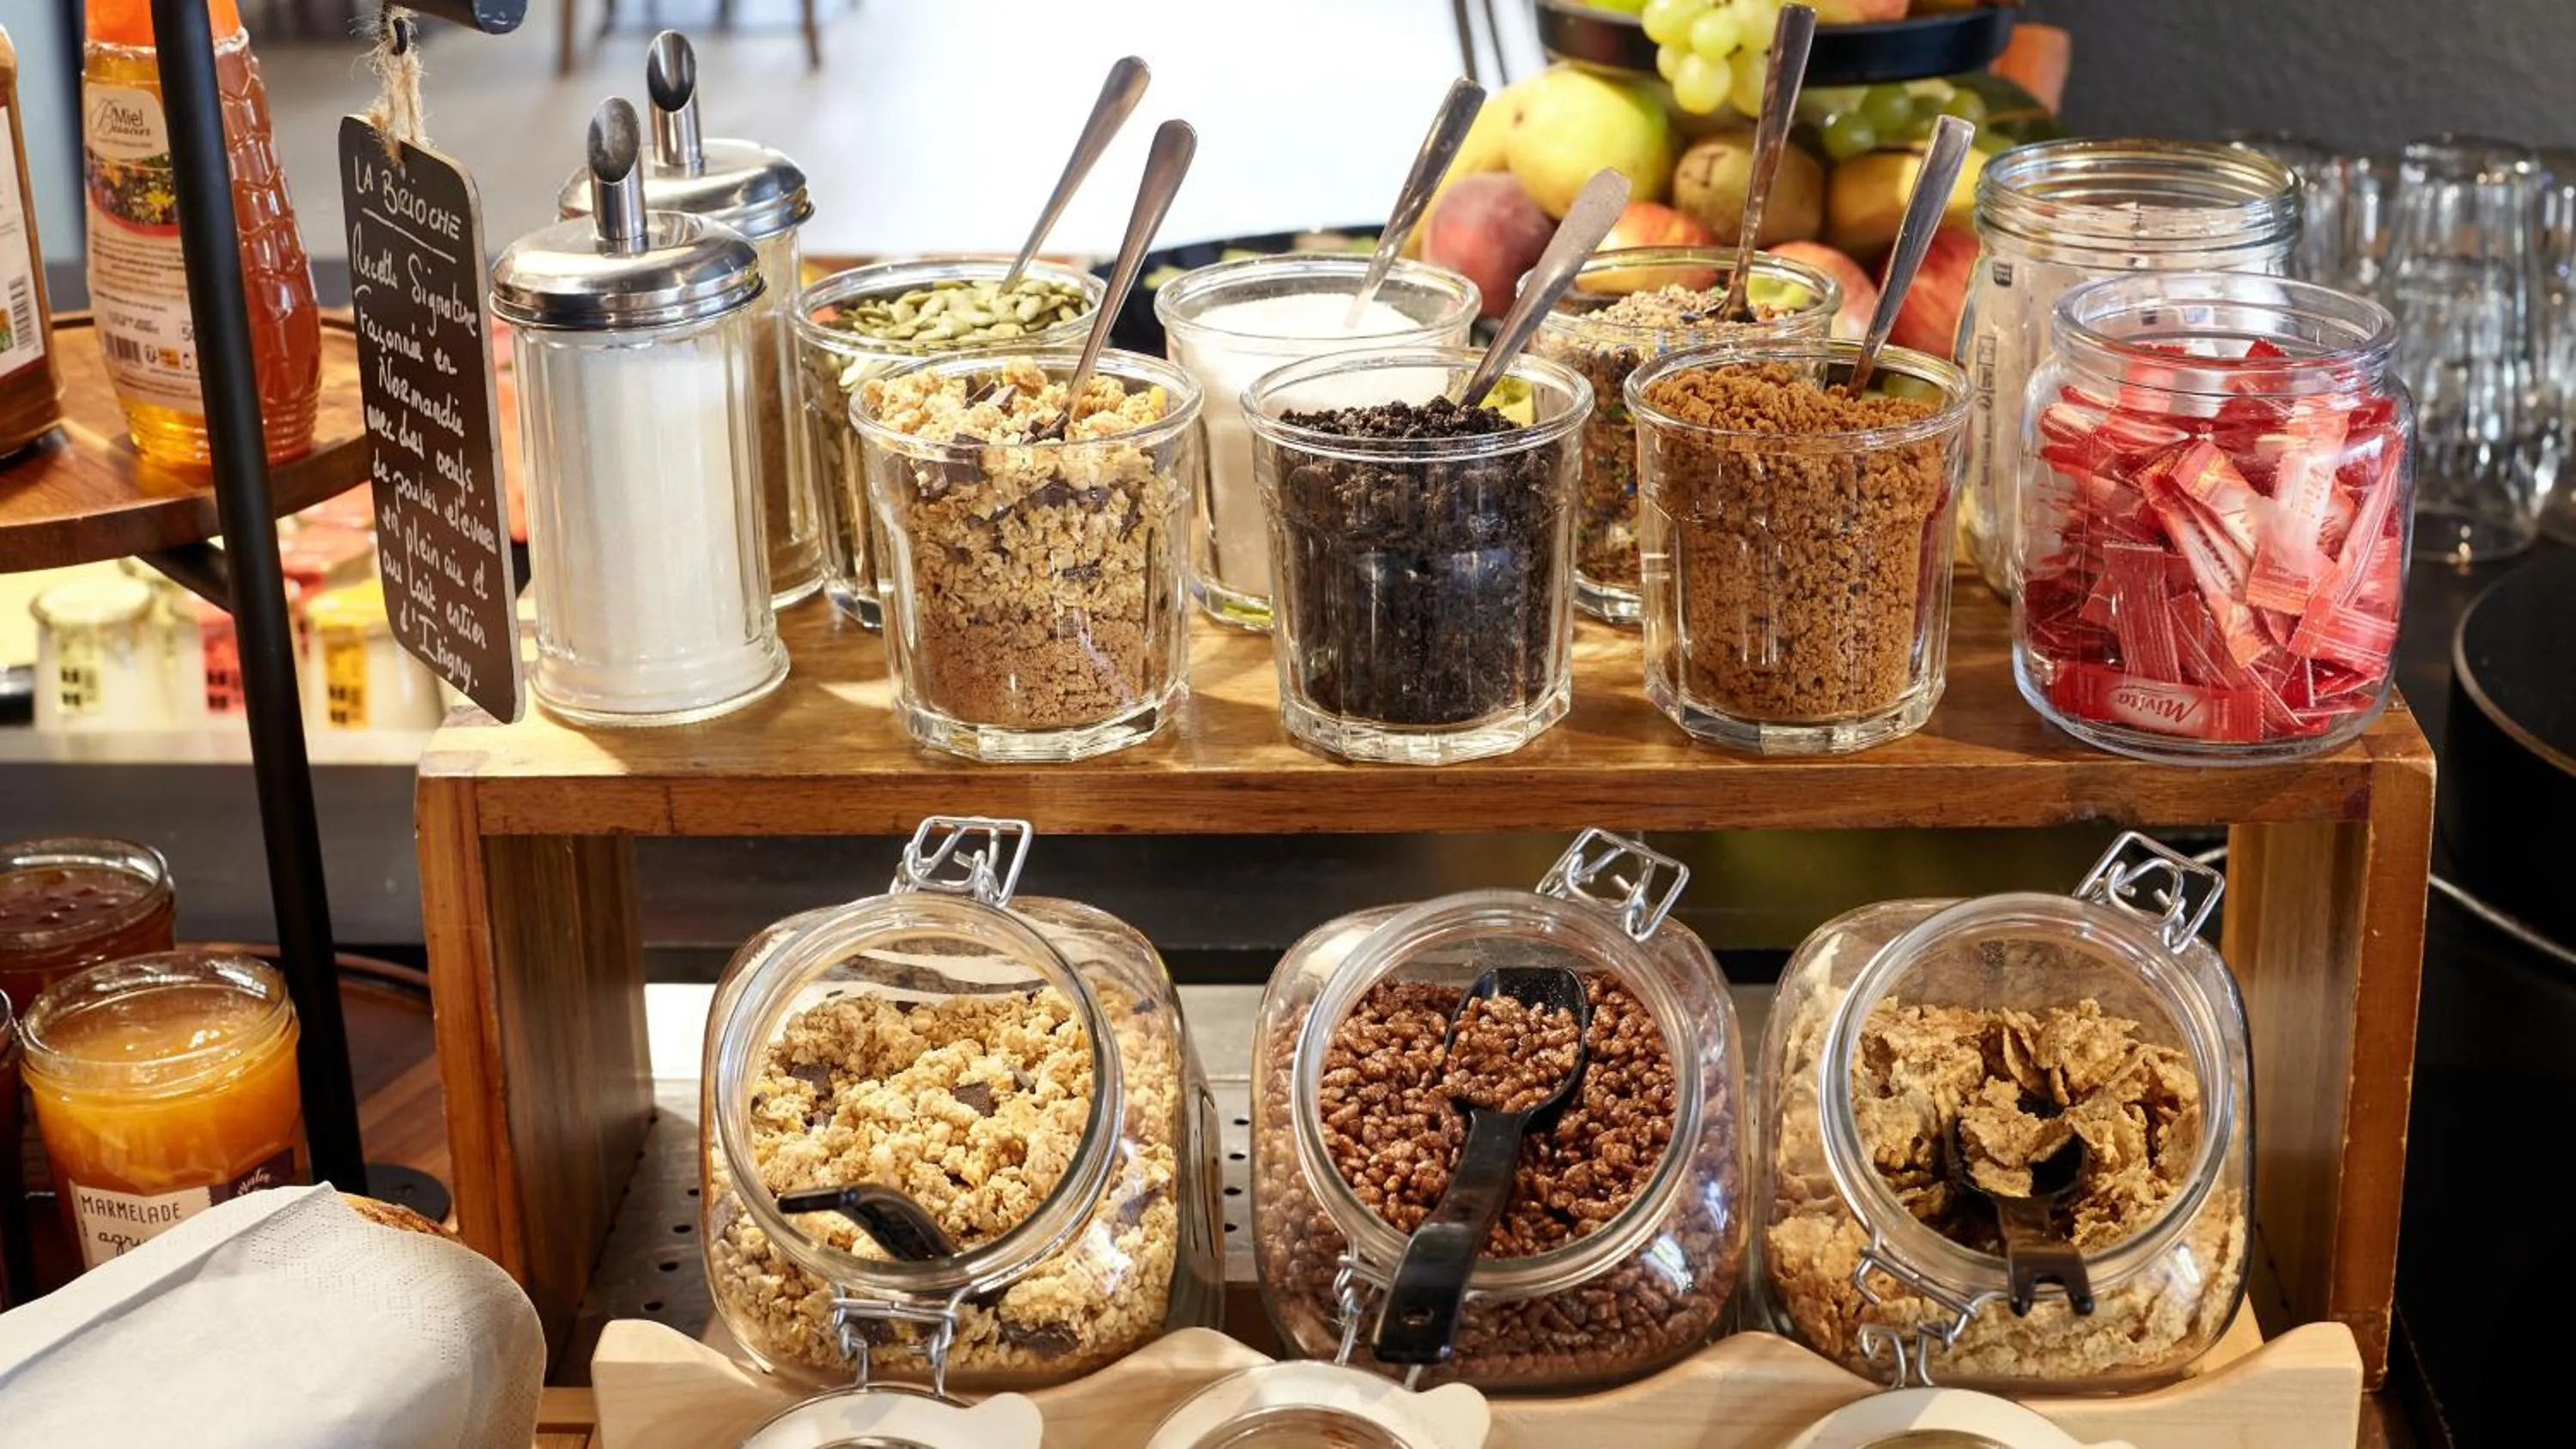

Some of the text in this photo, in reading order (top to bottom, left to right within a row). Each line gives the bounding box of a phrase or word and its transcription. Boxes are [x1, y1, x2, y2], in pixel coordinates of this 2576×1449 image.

[112, 107, 143, 126] Miel
[355, 155, 461, 240] LA BRIOCHE
[373, 447, 389, 482] de
[405, 516, 440, 570] plein
[382, 549, 403, 585] au
[2117, 690, 2201, 723] Mivita
[81, 1194, 180, 1224] MARMELADE
[97, 1231, 151, 1257] agru
